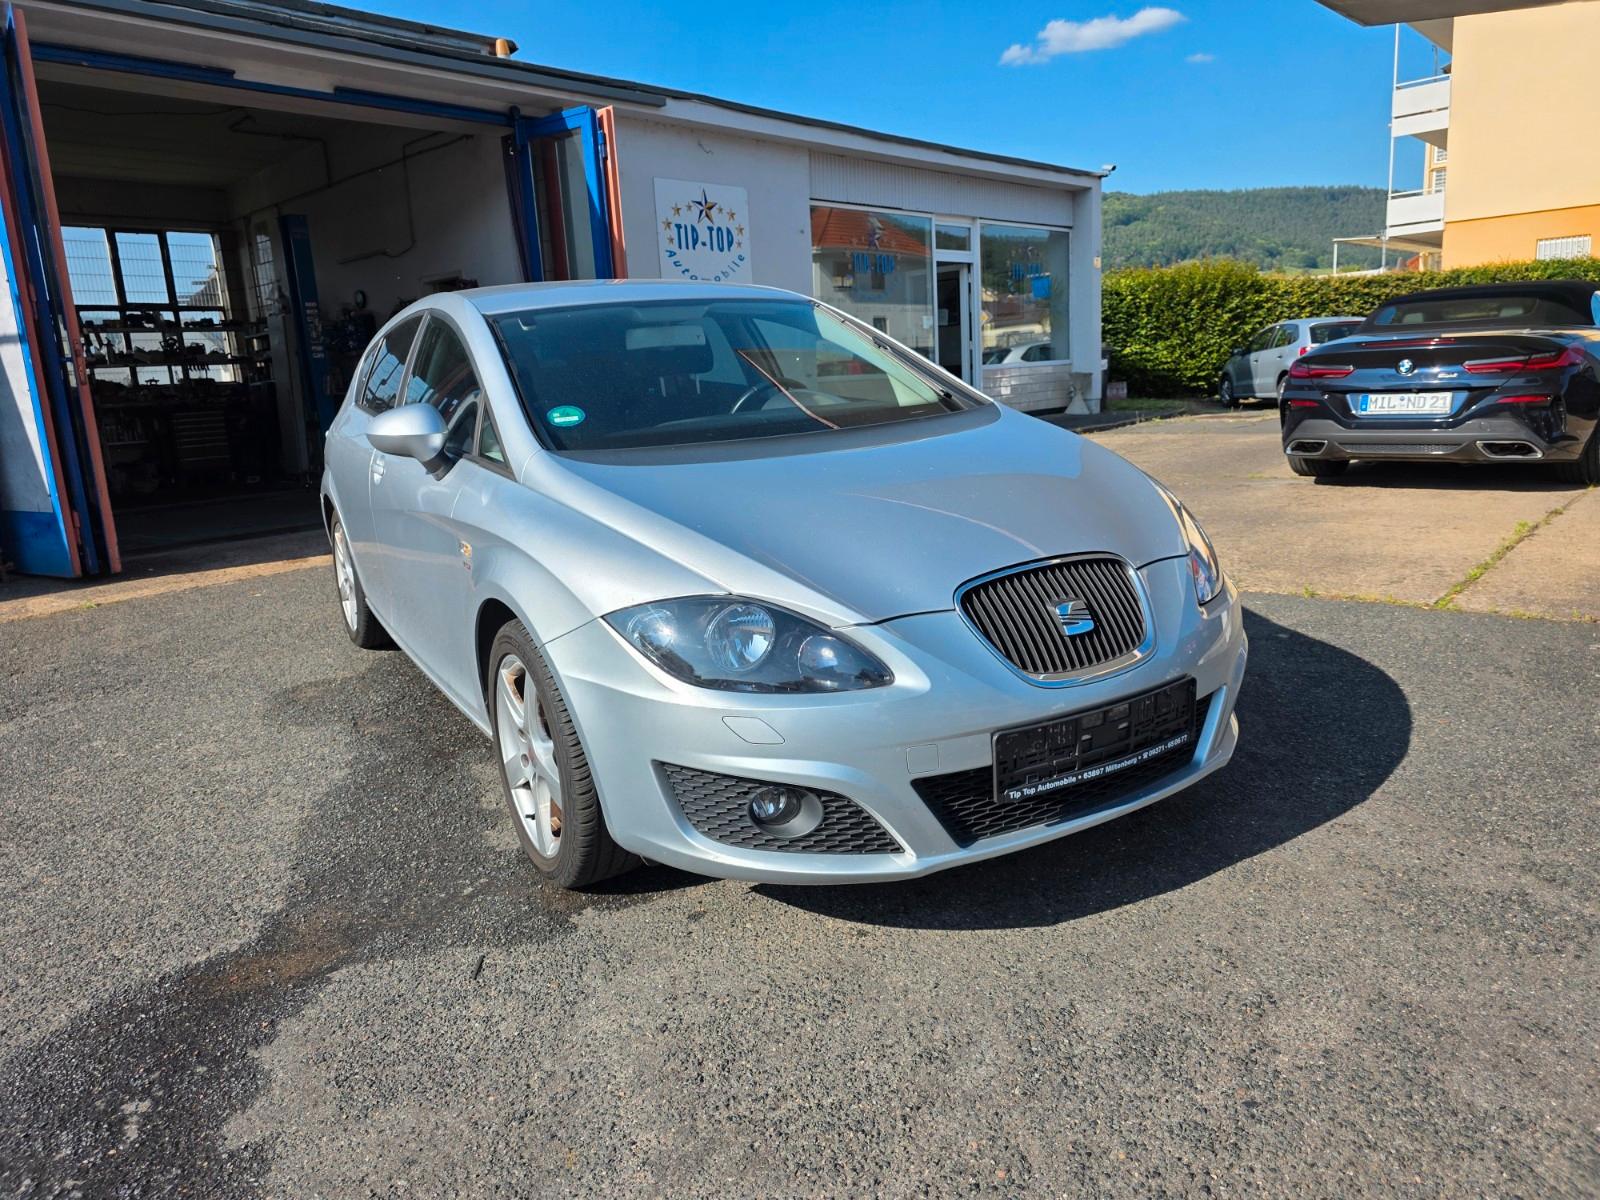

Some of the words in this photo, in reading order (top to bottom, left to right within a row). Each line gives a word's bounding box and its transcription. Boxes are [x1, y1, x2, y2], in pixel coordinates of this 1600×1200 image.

[674, 223, 734, 252] TIP-TOP
[1370, 396, 1396, 410] MIL
[1406, 395, 1427, 408] ND
[1009, 790, 1021, 799] Tip
[1023, 786, 1036, 796] Top
[1037, 776, 1077, 792] Automobile
[1083, 767, 1104, 780] 63897
